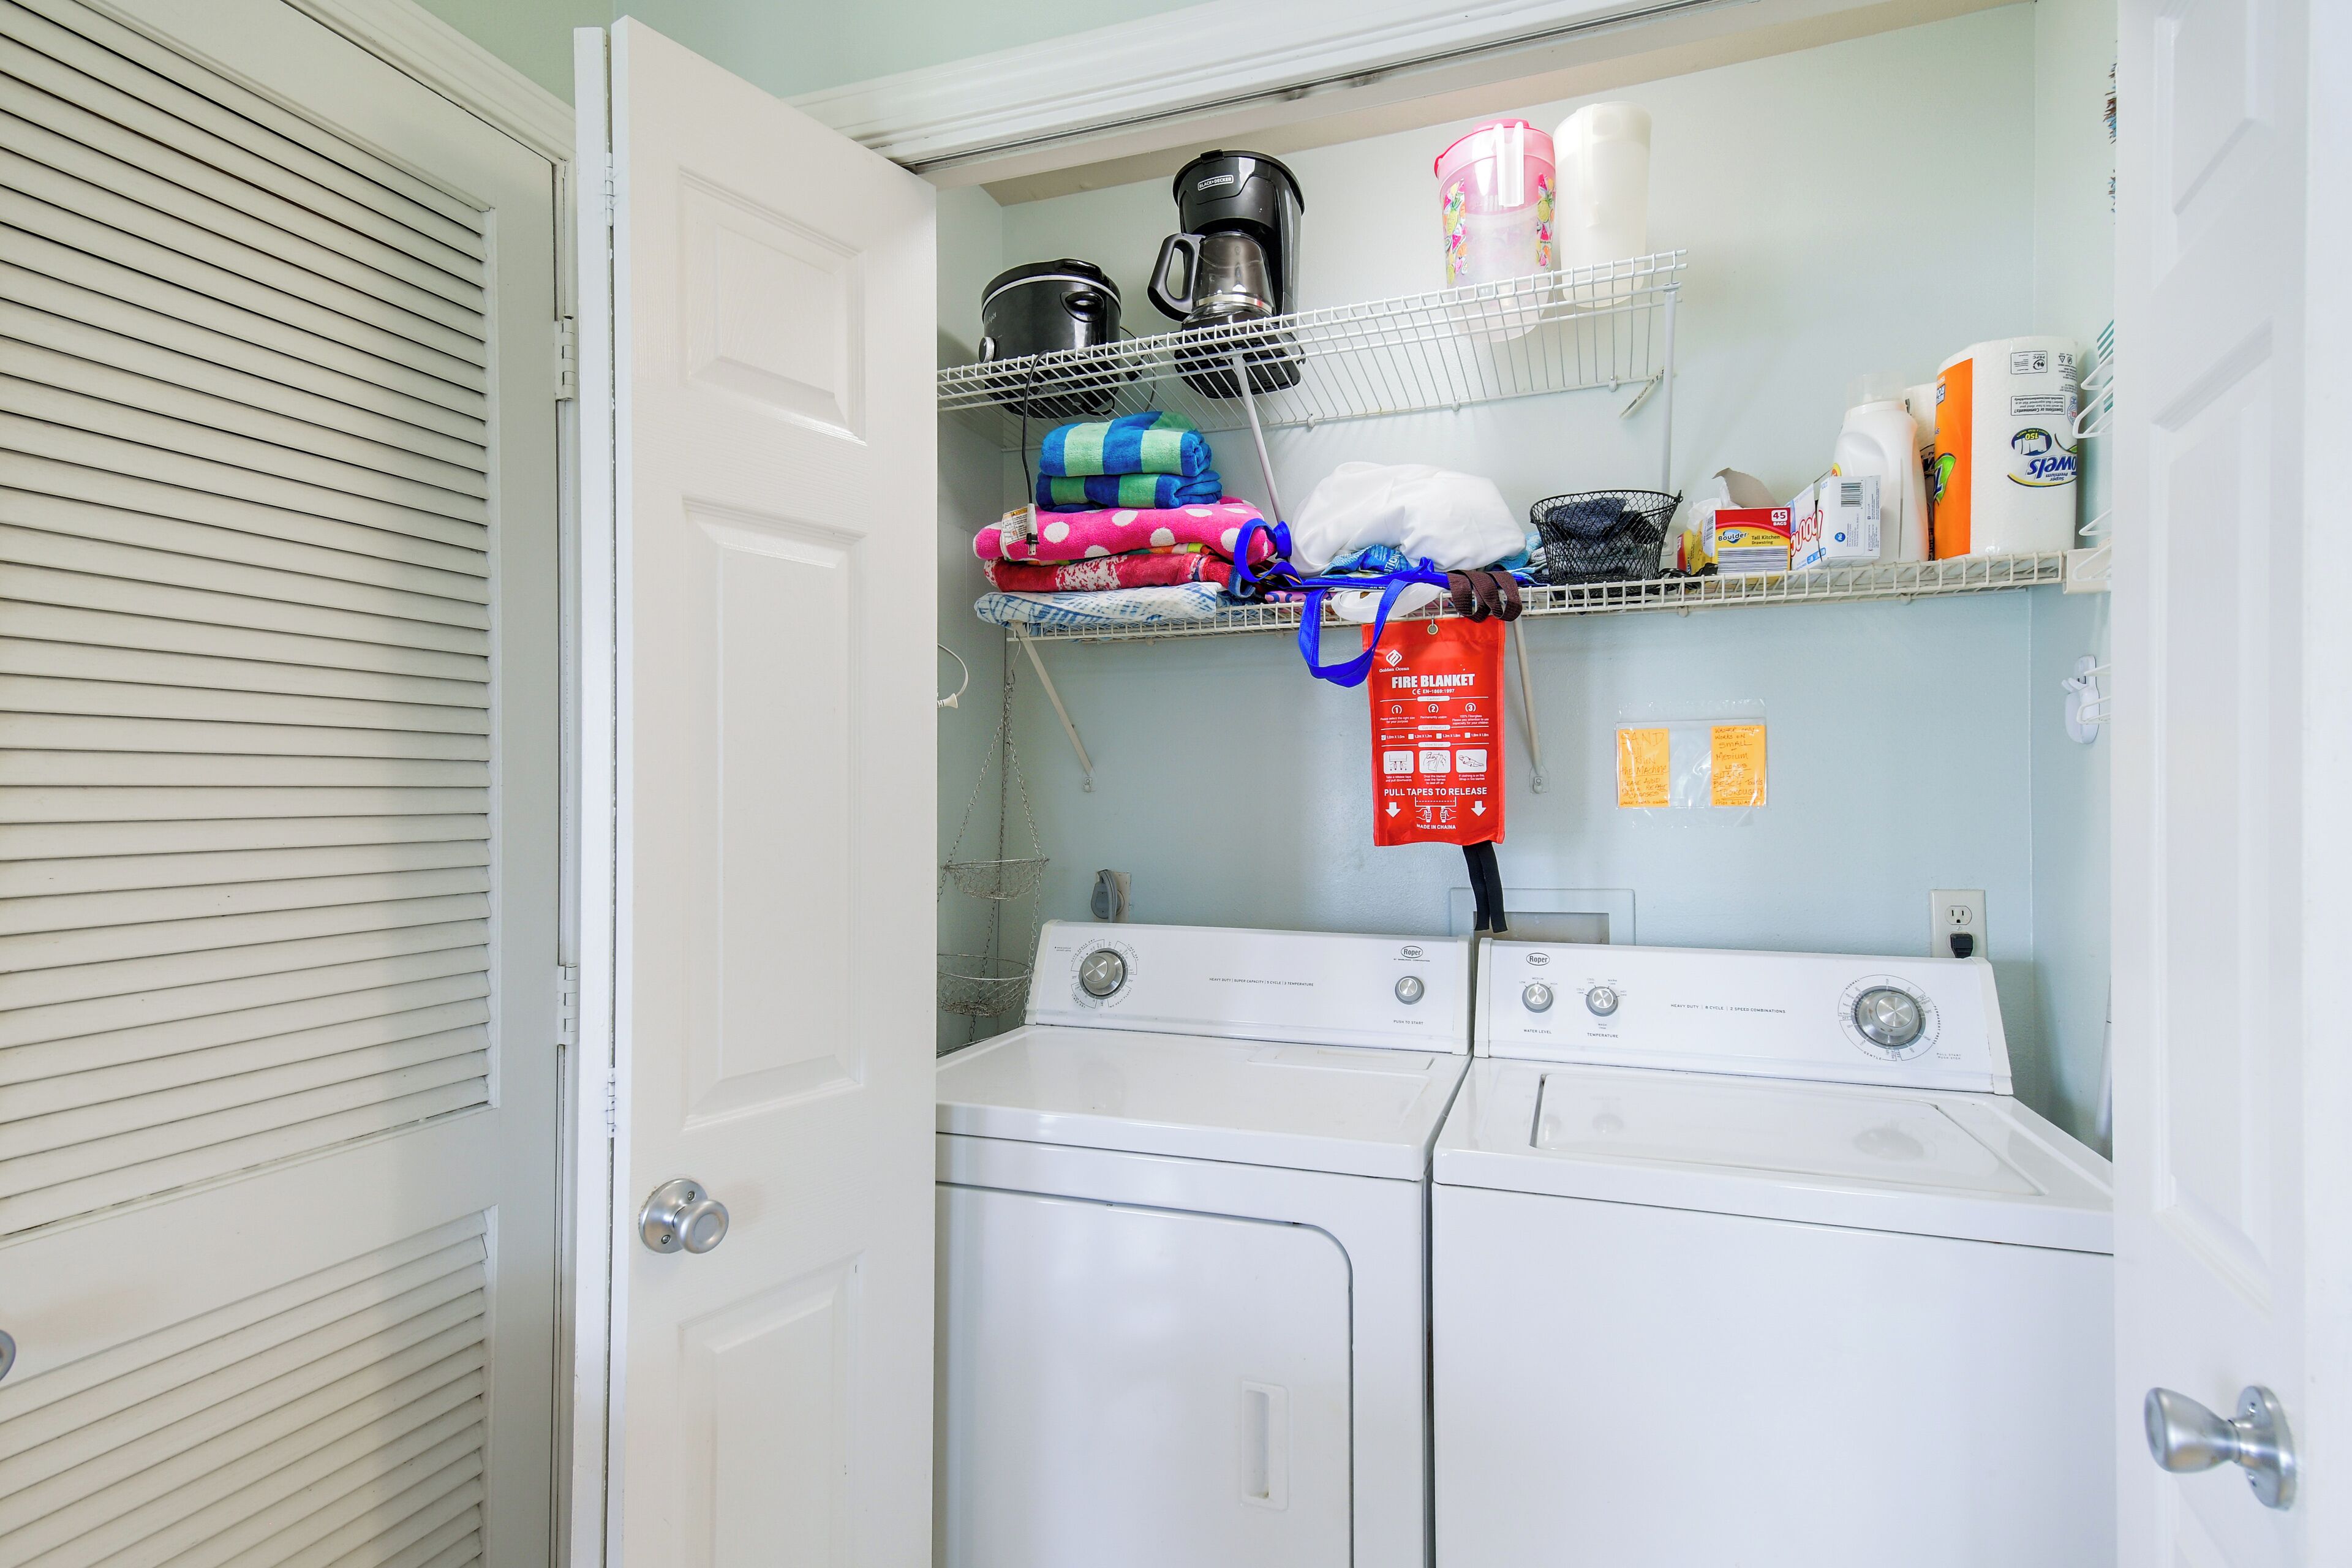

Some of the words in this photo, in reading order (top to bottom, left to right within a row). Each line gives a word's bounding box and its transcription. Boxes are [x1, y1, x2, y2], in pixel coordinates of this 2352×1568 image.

[1718, 532, 1747, 541] Boulder
[1392, 676, 1418, 689] FIRE
[1420, 674, 1476, 687] BLANKET
[1621, 732, 1664, 747] SAND
[1863, 1050, 1882, 1060] GENTLE
